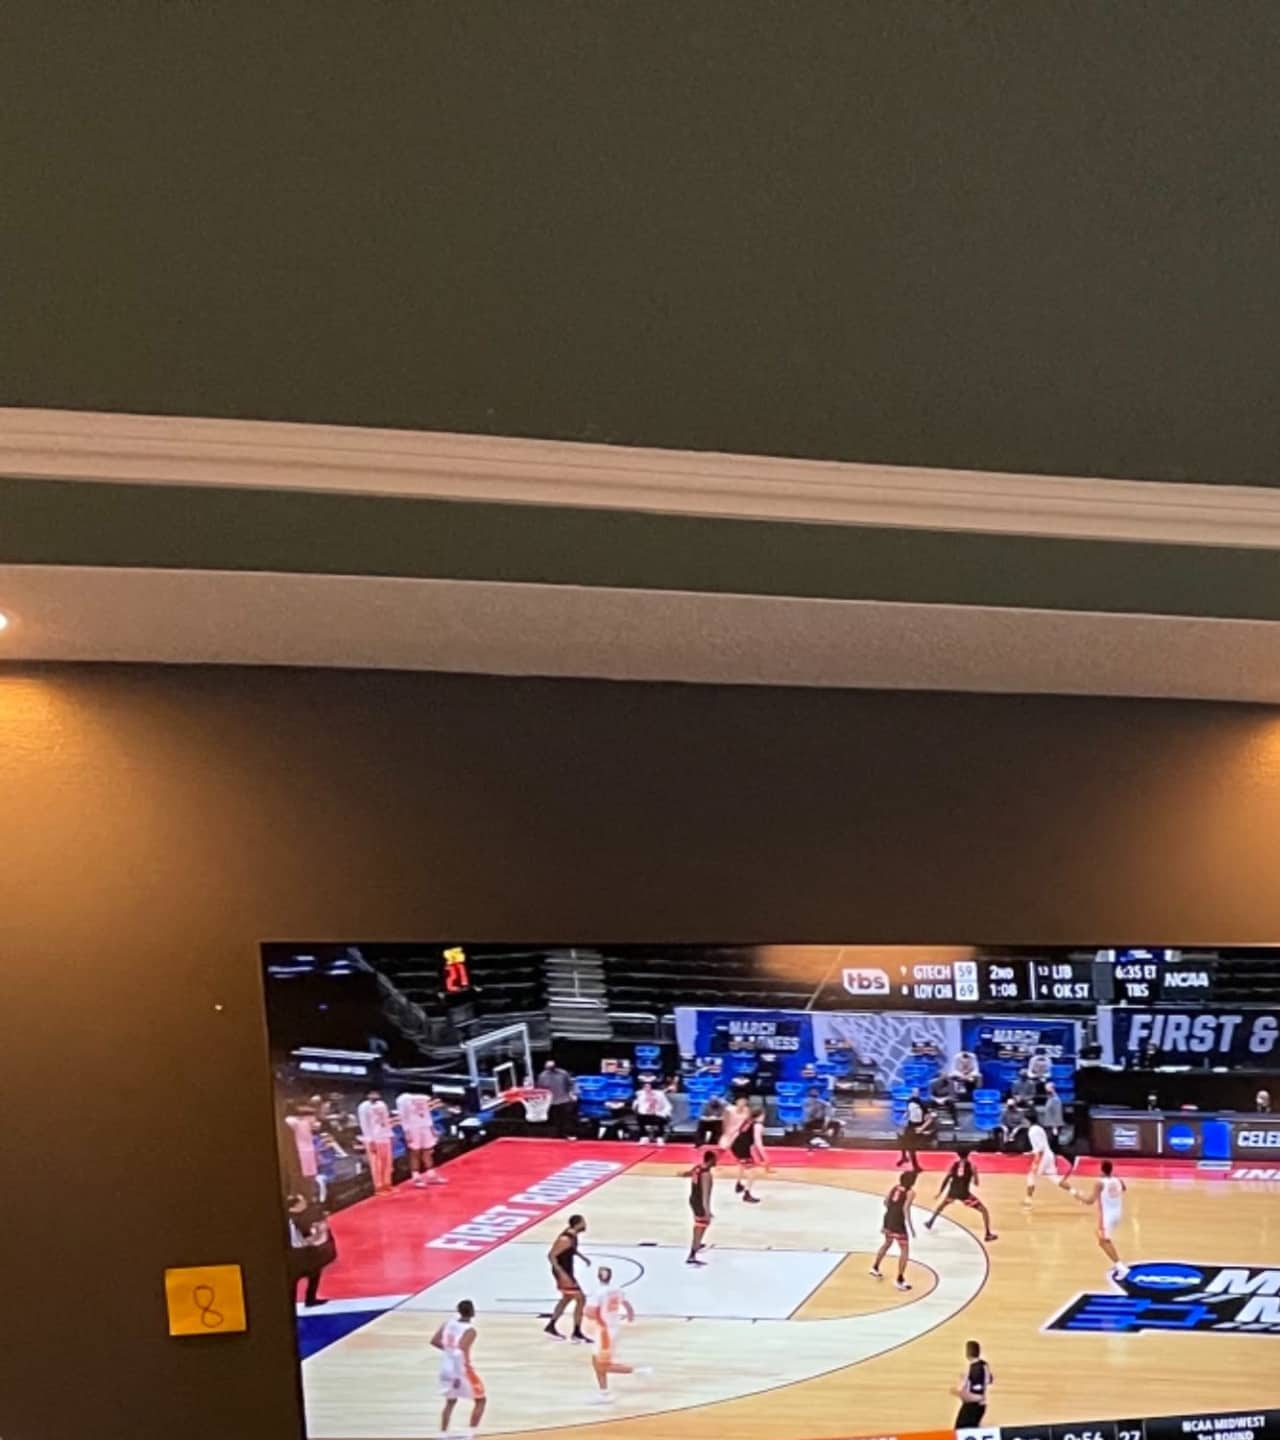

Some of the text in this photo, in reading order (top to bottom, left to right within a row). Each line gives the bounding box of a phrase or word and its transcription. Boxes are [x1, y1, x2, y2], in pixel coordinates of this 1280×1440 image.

[846, 972, 887, 991] tbs
[1163, 971, 1210, 988] NCAA
[1128, 1014, 1279, 1053] FIRST &
[425, 1204, 533, 1252] FIRST
[192, 1285, 224, 1329] 8
